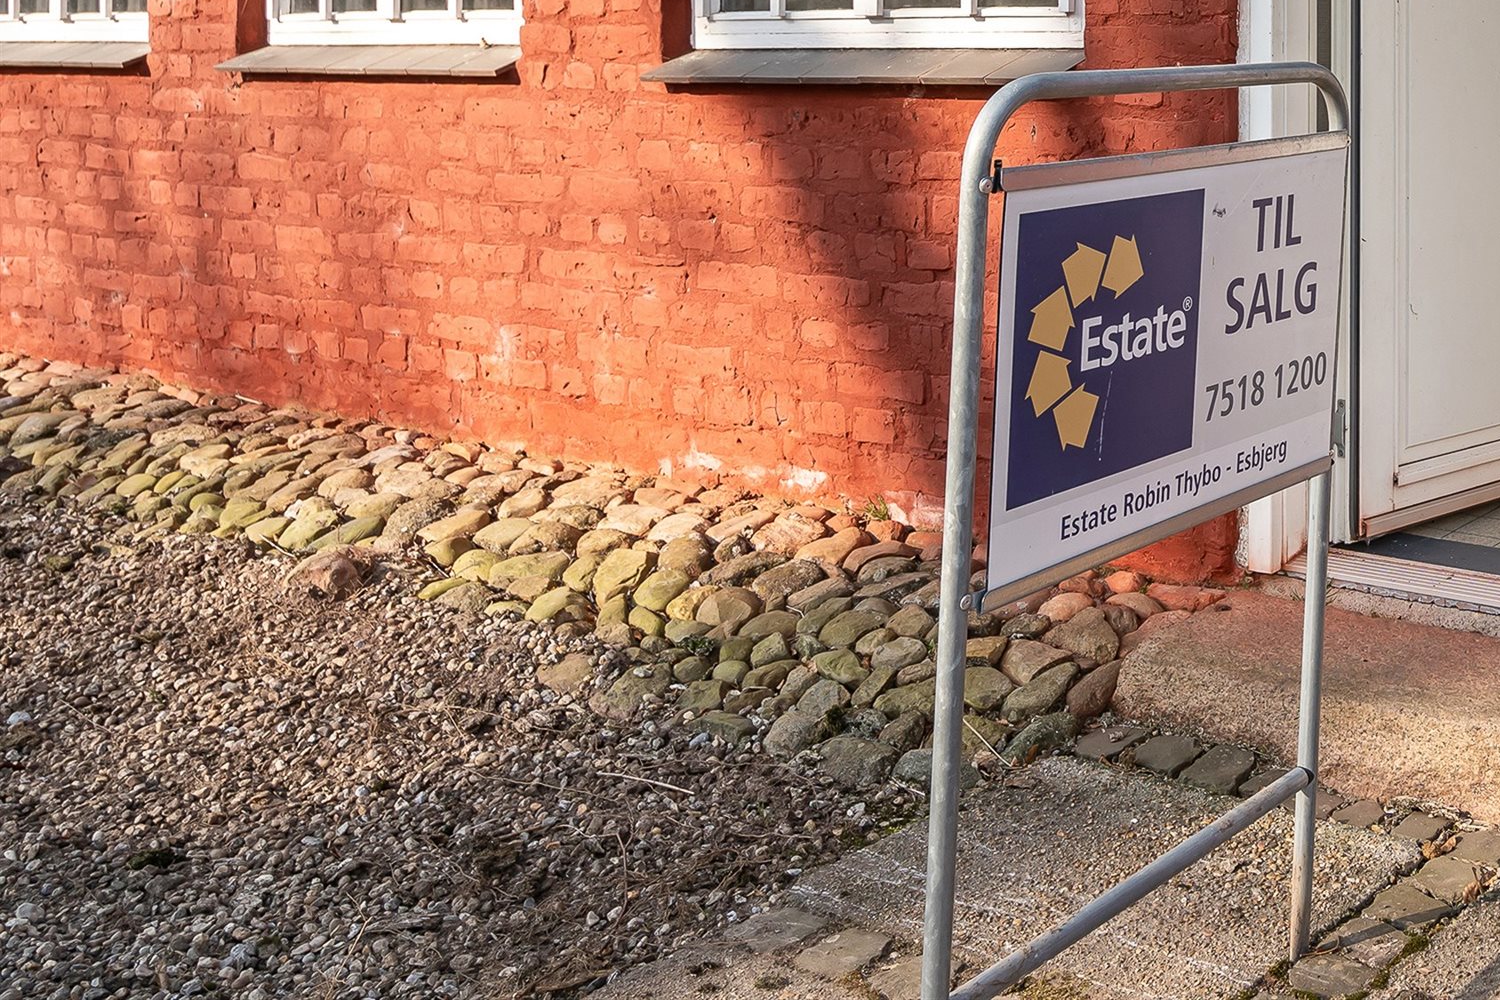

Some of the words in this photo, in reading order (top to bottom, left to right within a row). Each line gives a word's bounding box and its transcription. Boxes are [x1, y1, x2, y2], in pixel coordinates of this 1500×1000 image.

[1252, 193, 1302, 253] TIL
[1225, 261, 1318, 335] SALG
[1205, 370, 1265, 422] 7518
[1274, 351, 1327, 399] 1200
[1060, 503, 1118, 541] Estate
[1123, 481, 1171, 517] Robin
[1175, 463, 1221, 497] Thybo
[1236, 440, 1288, 474] Esbjerg
